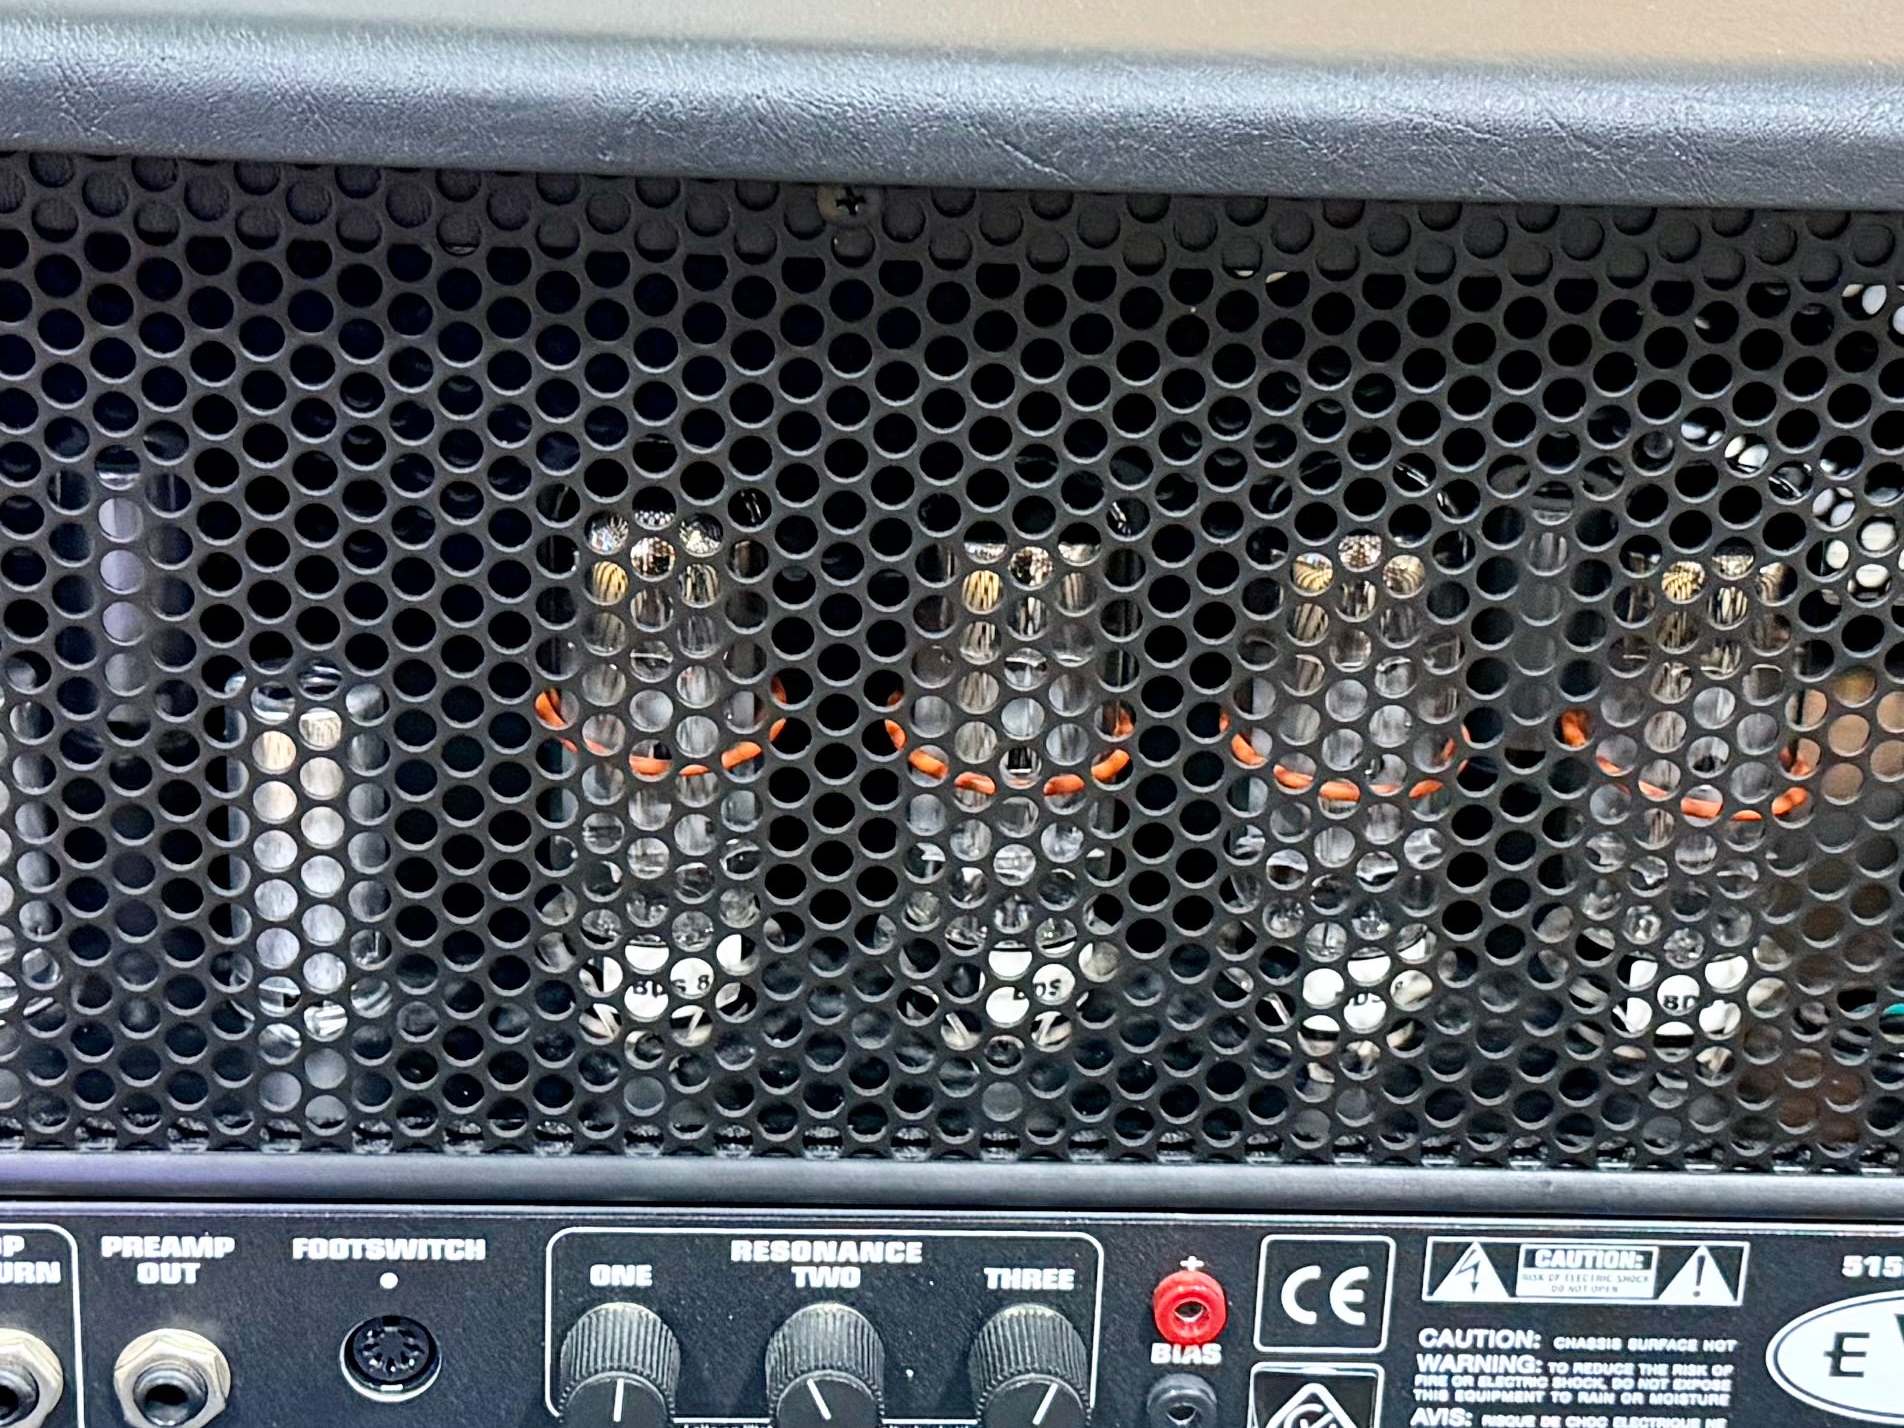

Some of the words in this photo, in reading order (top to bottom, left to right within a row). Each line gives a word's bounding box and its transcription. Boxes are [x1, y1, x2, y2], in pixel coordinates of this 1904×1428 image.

[101, 1235, 236, 1258] PREAMP
[292, 1237, 486, 1261] FOOTSWITCH
[730, 1239, 923, 1263] RESONANCE
[1534, 1249, 1644, 1269] CAUTION:
[137, 1262, 201, 1285] OUT
[589, 1263, 653, 1288] ONE
[791, 1265, 862, 1289] TWO
[983, 1267, 1075, 1291] THREE
[1281, 1265, 1370, 1326] CE
[1419, 1328, 1541, 1349] CAUTION:
[1553, 1337, 1622, 1351] CHASSIS
[1627, 1338, 1697, 1352] SURFACE
[1703, 1339, 1737, 1353] NOT
[1150, 1342, 1222, 1364] BIAS
[1416, 1354, 1543, 1374] WARNING:
[1547, 1362, 1569, 1375] TO
[1572, 1362, 1635, 1376] REDUCE
[1639, 1363, 1669, 1377] THE
[1672, 1364, 1708, 1377] RISK
[1711, 1364, 1734, 1377] OF
[1414, 1375, 1448, 1388] FIRE
[1451, 1375, 1474, 1388] OR
[1477, 1376, 1548, 1389] ELECTRIC
[1612, 1377, 1634, 1391] DO
[1637, 1378, 1669, 1391] NOT
[1672, 1378, 1732, 1392] EXPOSE
[1413, 1389, 1449, 1402] THIS
[1454, 1390, 1546, 1404] EQUIPMENT
[1550, 1390, 1572, 1404] TO
[1577, 1391, 1616, 1405] RAIN
[1620, 1392, 1645, 1405] OR
[1648, 1392, 1731, 1406] MOISTURE
[1410, 1407, 1473, 1428] AVIS:
[1481, 1414, 1536, 1428] RISQUE
[1540, 1416, 1561, 1428] DE
